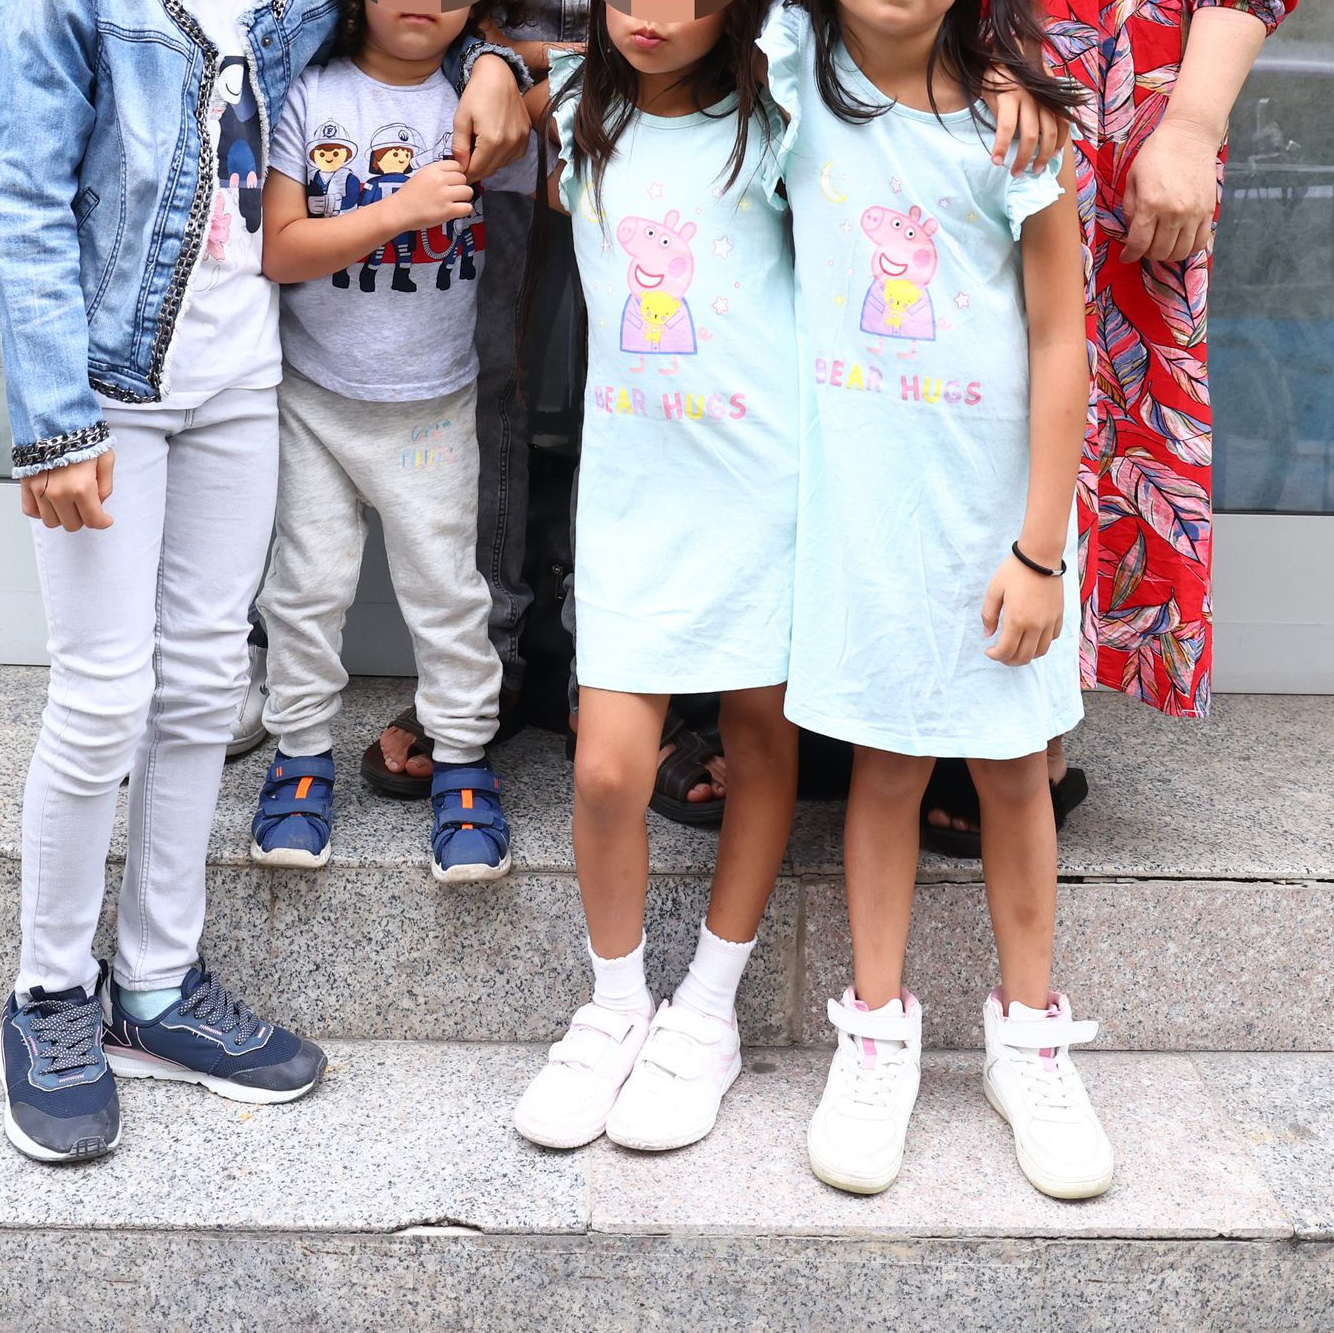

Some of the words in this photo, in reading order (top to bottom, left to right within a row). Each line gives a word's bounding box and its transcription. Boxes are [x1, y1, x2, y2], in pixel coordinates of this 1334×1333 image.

[595, 386, 648, 416] BEAR
[662, 392, 747, 420] HUGS
[900, 375, 982, 406] HUGS
